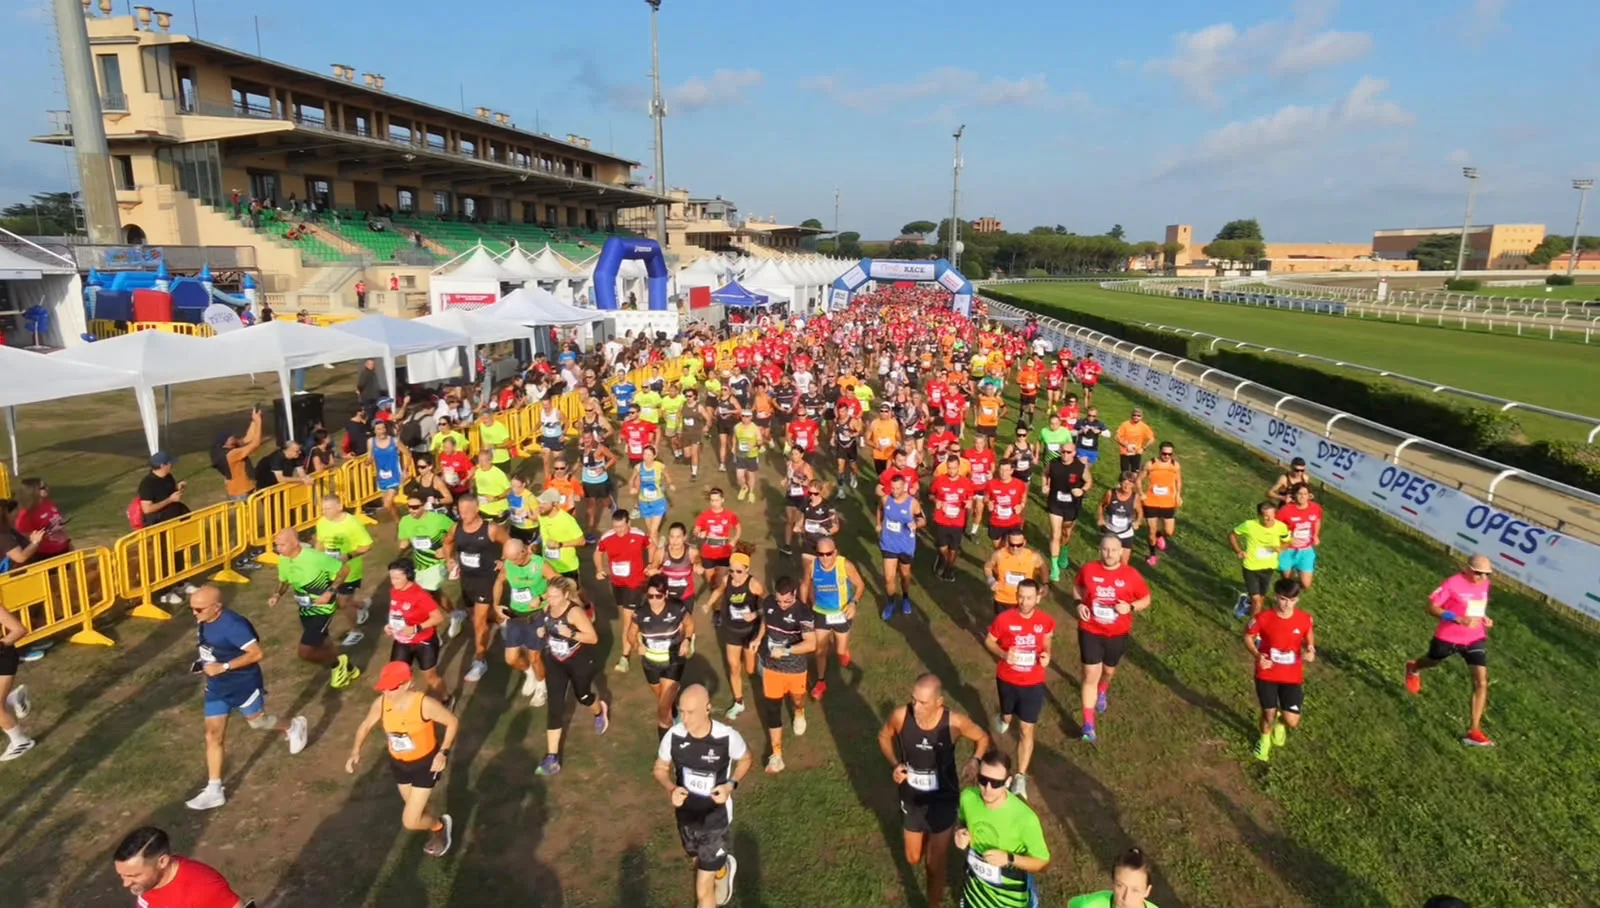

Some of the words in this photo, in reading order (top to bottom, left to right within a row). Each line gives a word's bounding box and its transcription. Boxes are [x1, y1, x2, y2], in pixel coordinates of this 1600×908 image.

[1168, 378, 1187, 396] OPES
[1196, 389, 1216, 409] OPES
[1227, 402, 1252, 426] OPES
[1268, 419, 1298, 448] OPES
[1378, 466, 1437, 506] OPES
[1465, 504, 1546, 554] OPES
[690, 779, 707, 791] 461
